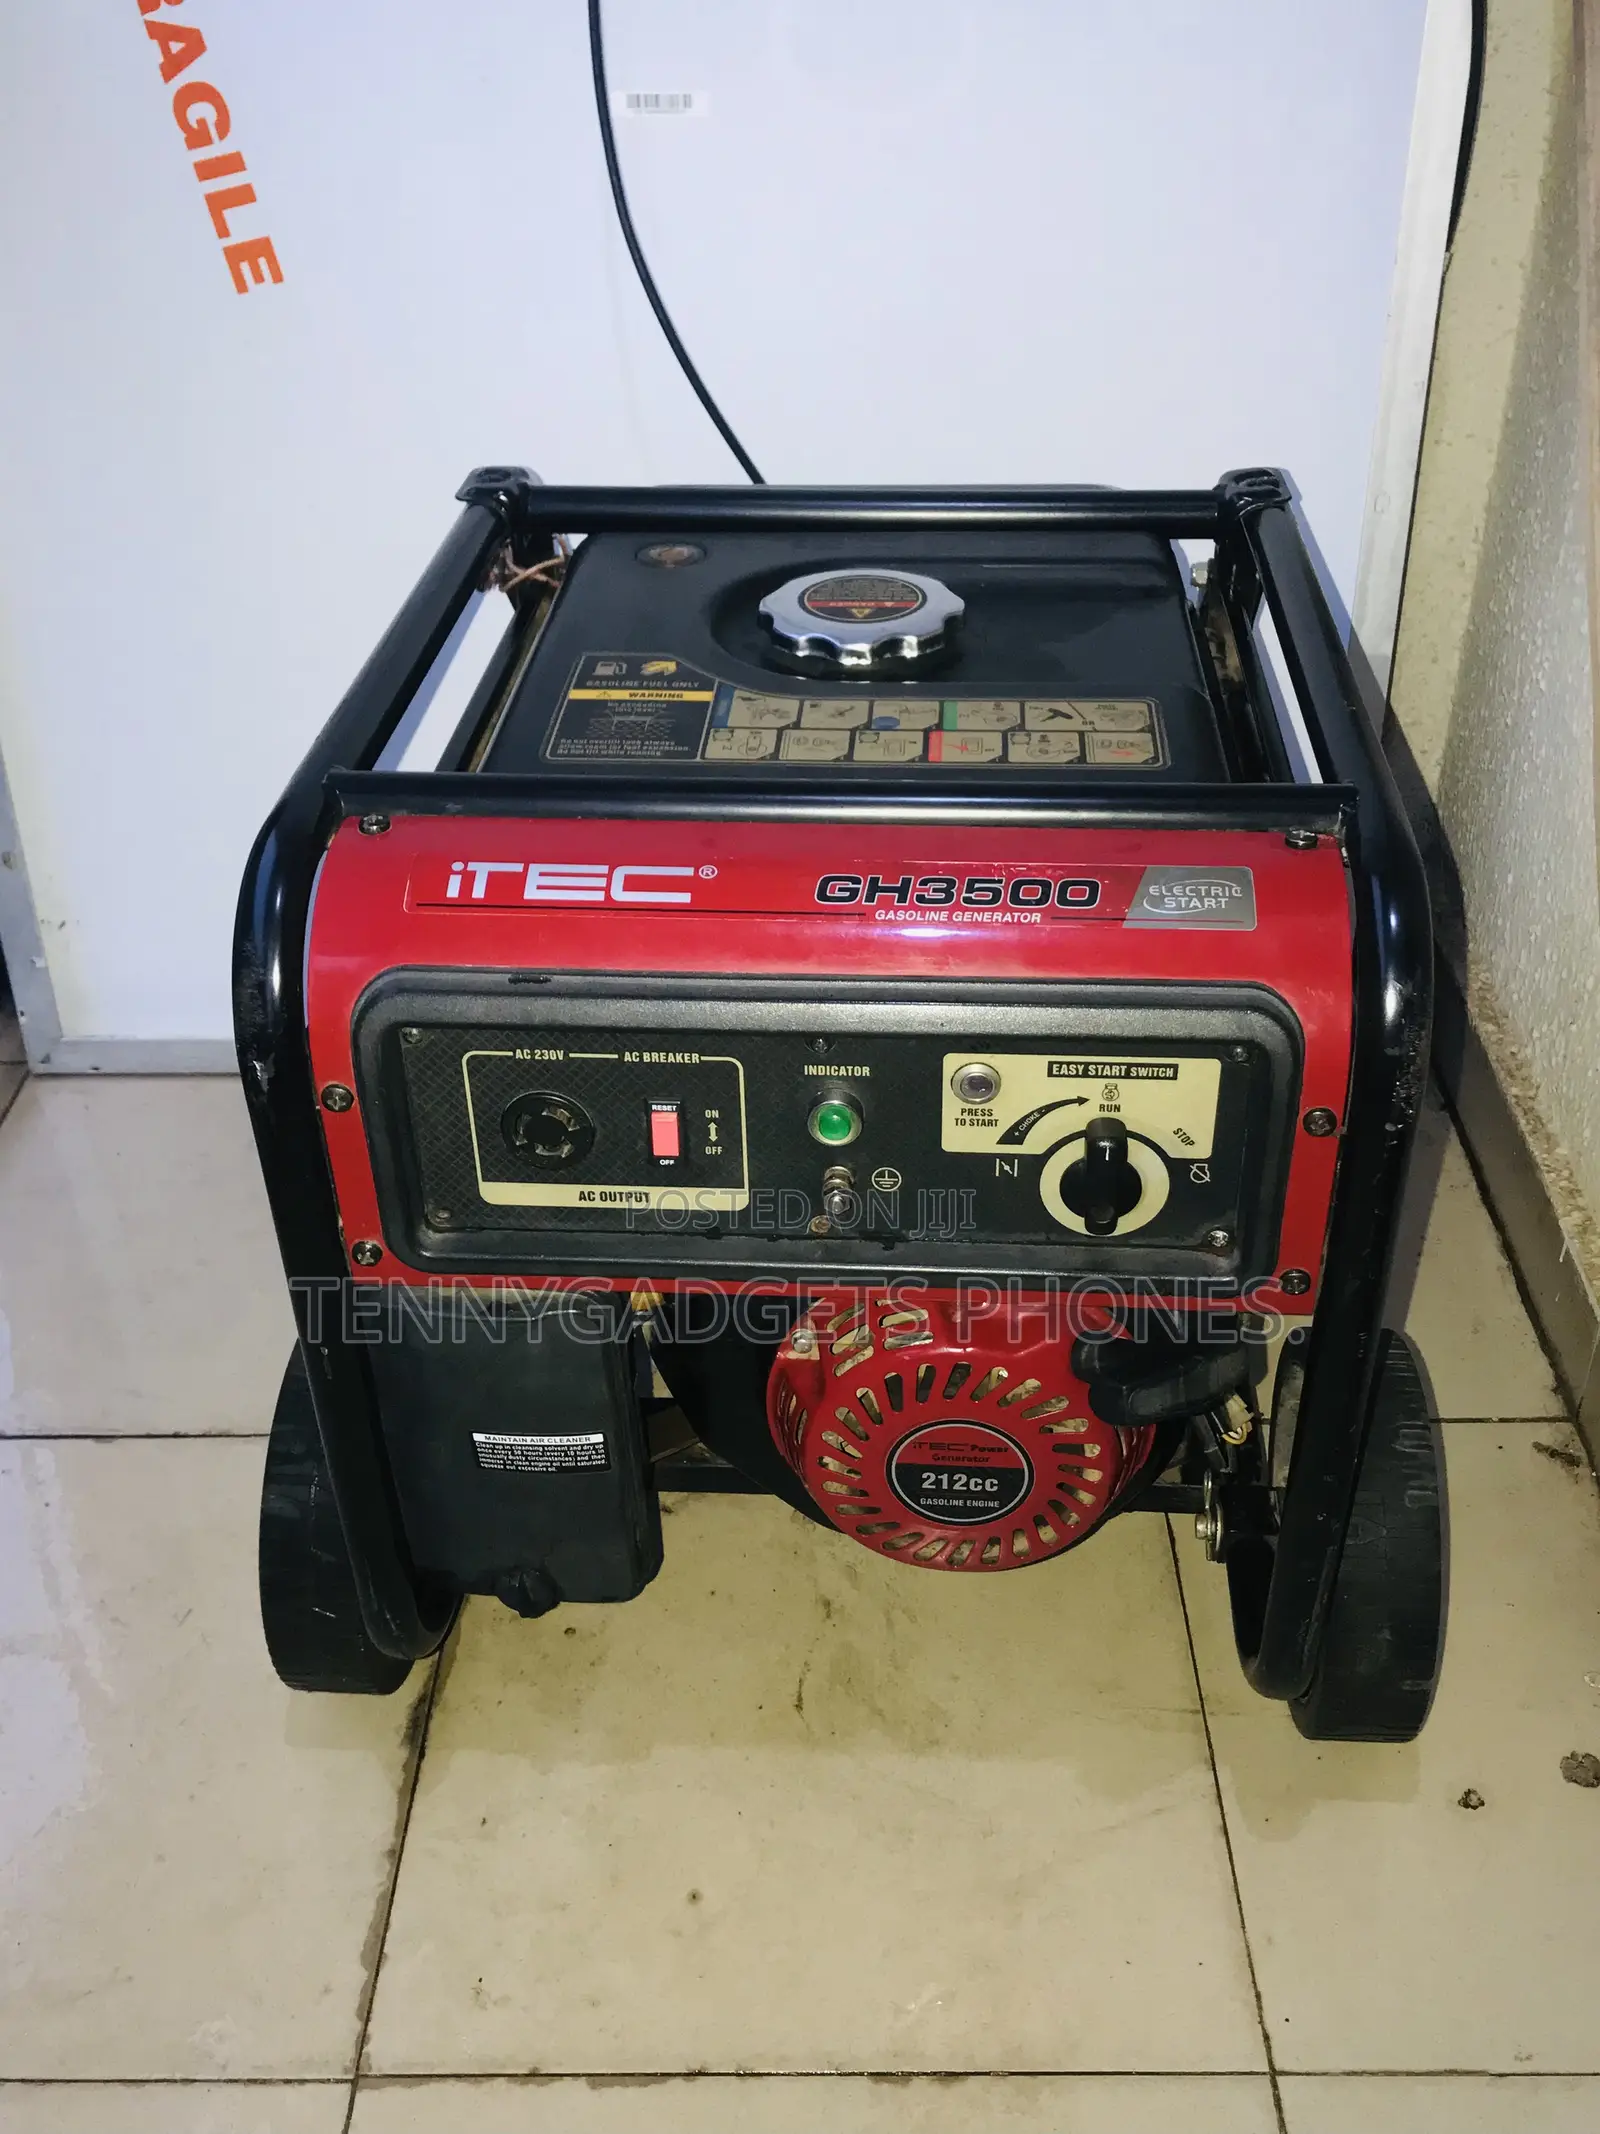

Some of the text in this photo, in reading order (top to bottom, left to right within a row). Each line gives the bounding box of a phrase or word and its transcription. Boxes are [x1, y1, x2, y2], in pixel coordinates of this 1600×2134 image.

[137, 0, 284, 294] AGILE
[814, 873, 1102, 909] GH3500
[1148, 883, 1242, 897] ELECTRIC
[1164, 896, 1229, 909] START
[875, 909, 1042, 924] GASOLINE GENERATOR
[515, 1050, 564, 1061] AC 230V
[624, 1051, 700, 1064] AC BREAKER
[804, 1065, 870, 1077] INDICATOR
[1052, 1064, 1174, 1078] EASY START SWITCH
[705, 1109, 719, 1119] ON
[960, 1108, 993, 1117] PRESS
[1099, 1103, 1121, 1113] RUN
[955, 1118, 999, 1127] TO START
[1018, 1111, 1041, 1132] CHOKE
[1173, 1127, 1195, 1148] STOP
[705, 1146, 723, 1155] OFF
[578, 1191, 650, 1204] AC OUTPUT
[484, 1435, 527, 1443] MAINTAIN
[547, 1436, 591, 1444] CLEANER
[912, 1440, 1009, 1453] iTEC Power
[932, 1453, 991, 1463] Generator
[921, 1472, 999, 1492] 212cc
[920, 1497, 1000, 1508] GASOLINE ENGINE
